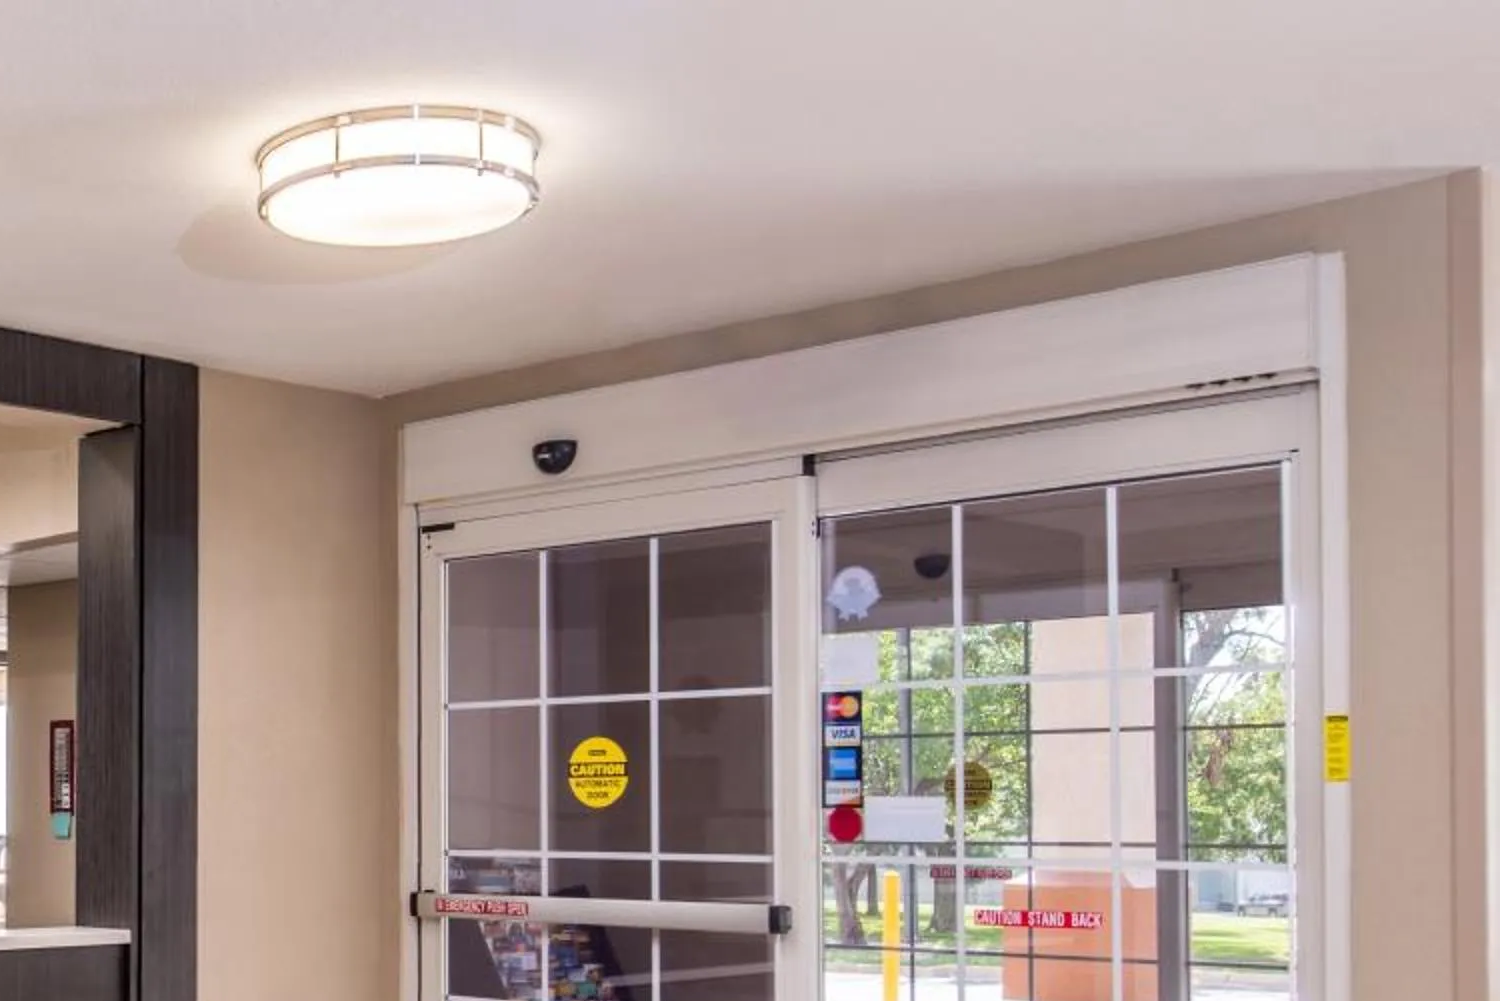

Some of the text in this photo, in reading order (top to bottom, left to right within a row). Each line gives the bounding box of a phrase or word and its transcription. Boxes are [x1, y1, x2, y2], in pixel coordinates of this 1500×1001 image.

[830, 727, 856, 740] VISA
[570, 763, 625, 777] CAUTION
[976, 910, 1102, 928] CAUTION STAND BACK
